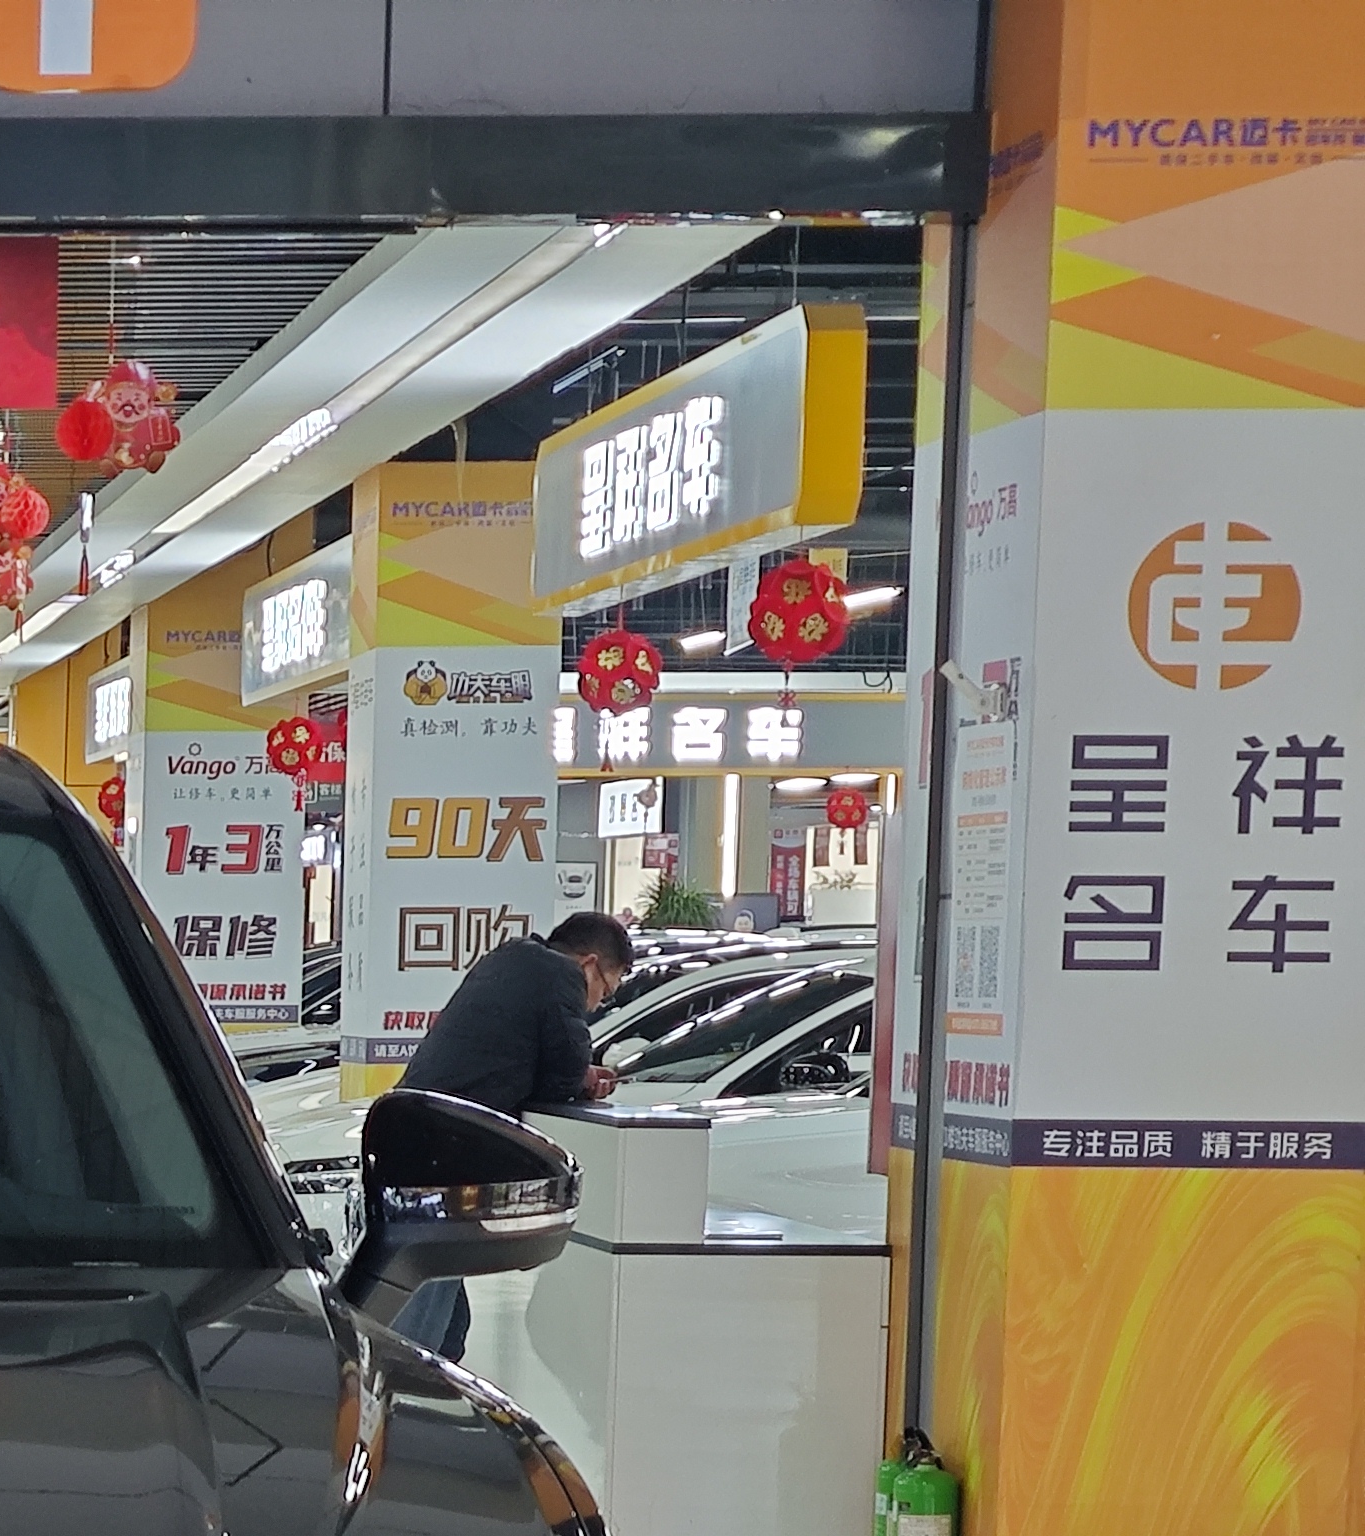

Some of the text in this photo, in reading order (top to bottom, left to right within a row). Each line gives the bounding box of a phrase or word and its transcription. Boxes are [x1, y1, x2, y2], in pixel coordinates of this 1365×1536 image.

[167, 755, 237, 780] Vango
[1068, 735, 1345, 835] 呈祥
[385, 797, 547, 862] 90天
[174, 914, 278, 960] 保修
[398, 904, 535, 972] 回购
[1061, 874, 1336, 973] 名车
[1041, 1129, 1333, 1160] 专注品质 精于服务
